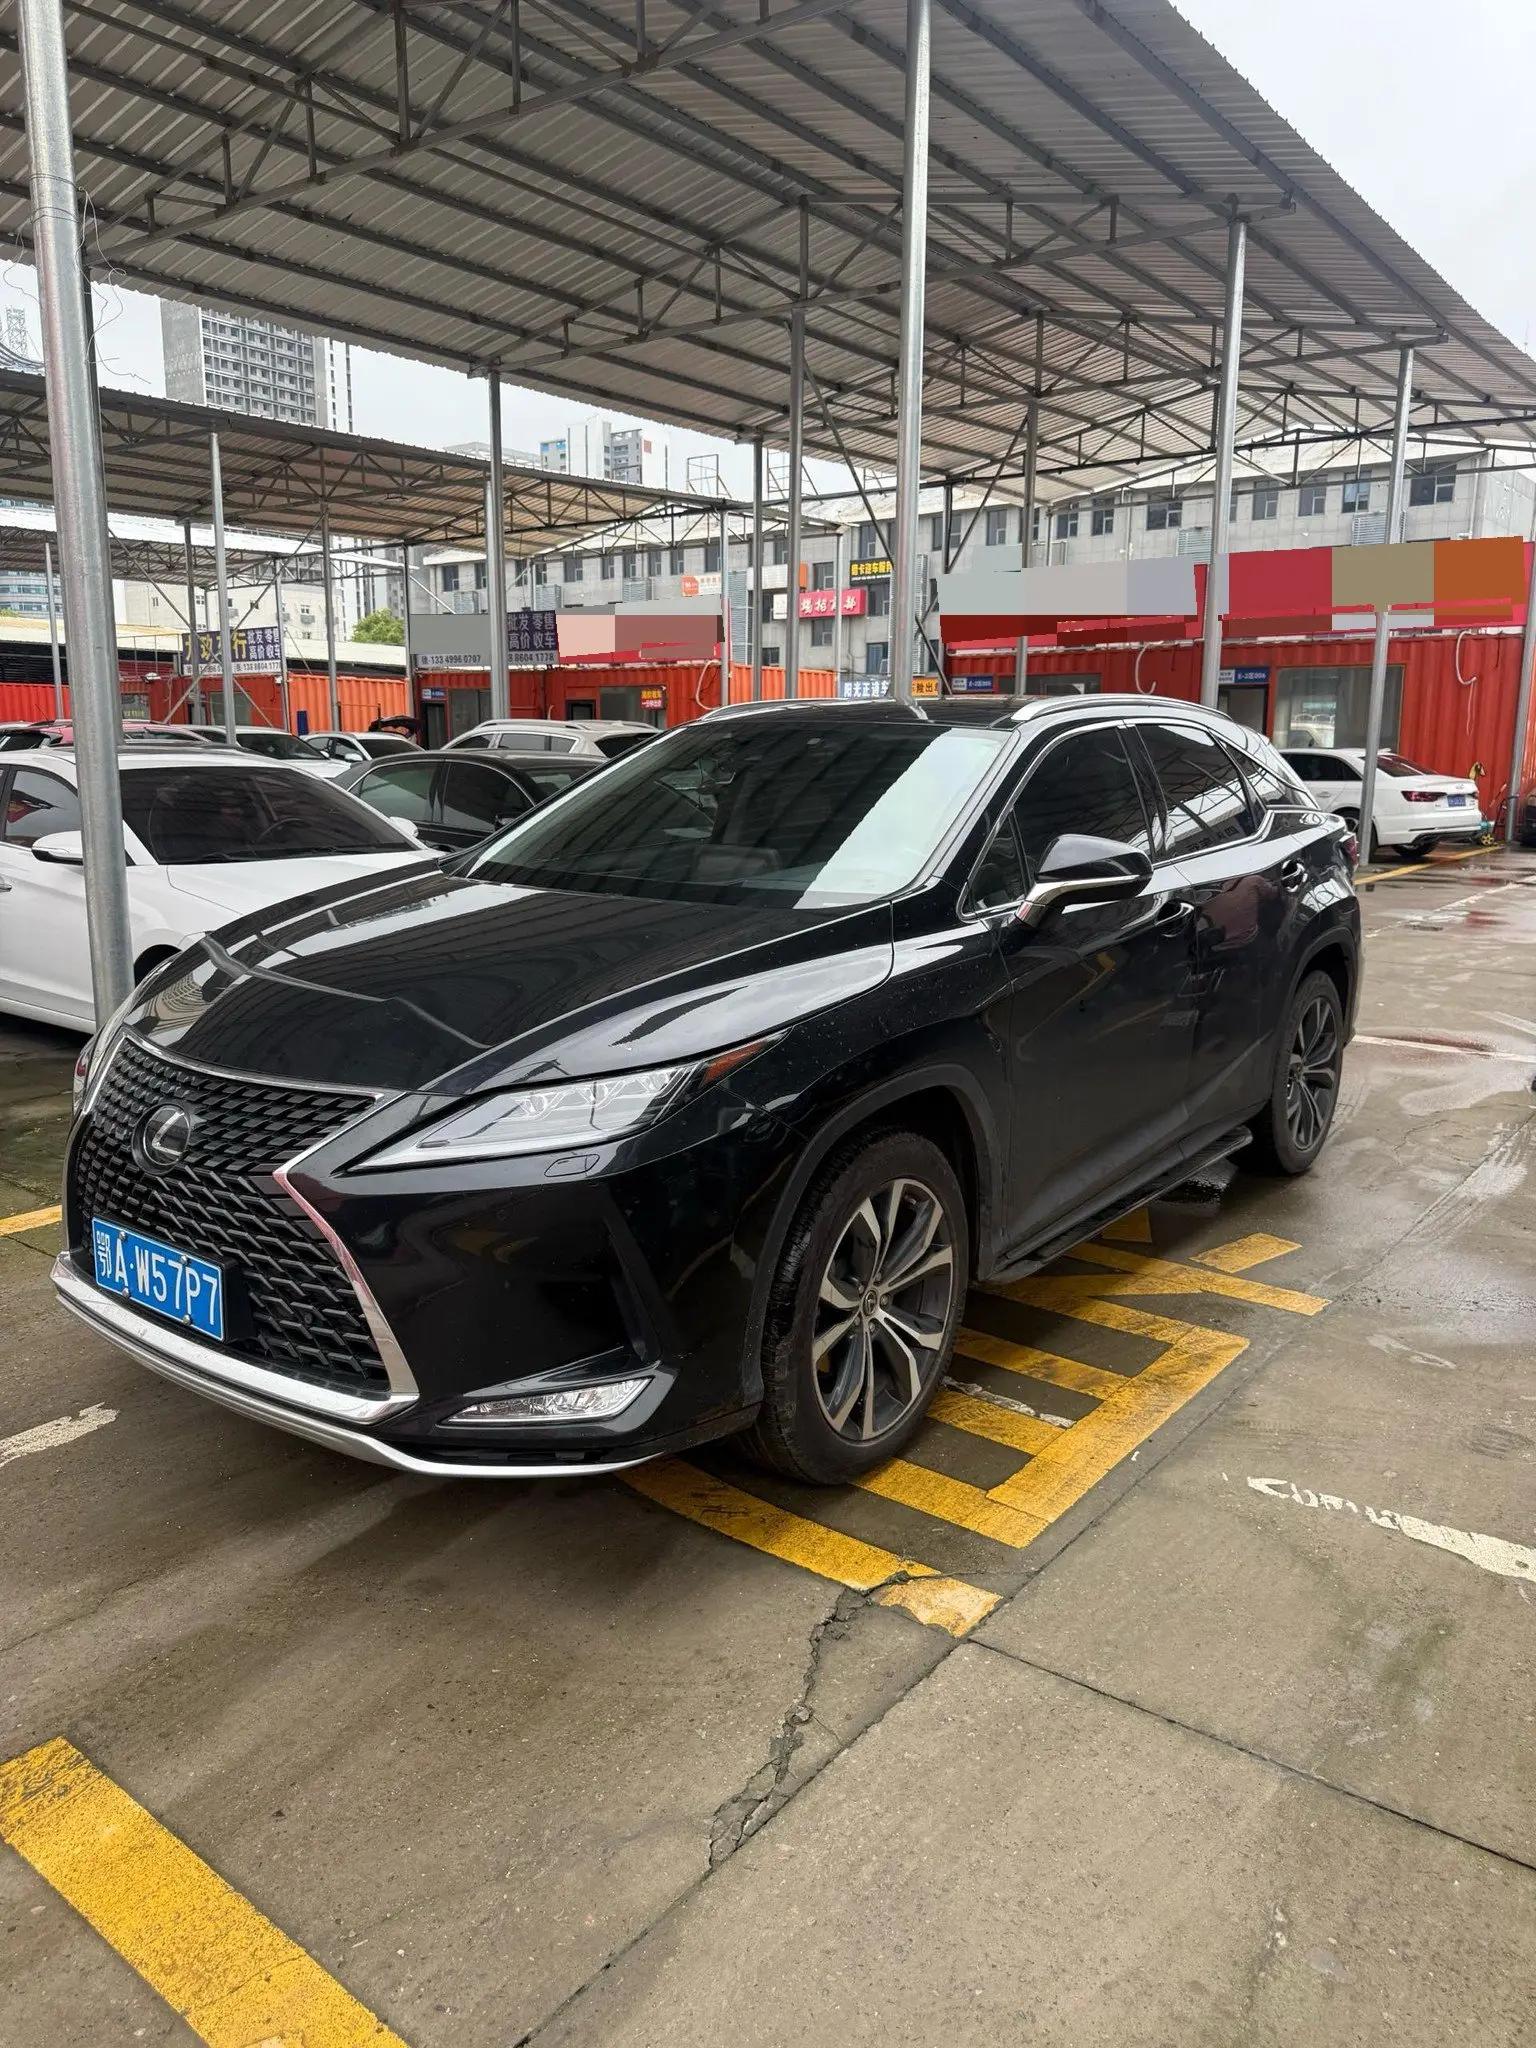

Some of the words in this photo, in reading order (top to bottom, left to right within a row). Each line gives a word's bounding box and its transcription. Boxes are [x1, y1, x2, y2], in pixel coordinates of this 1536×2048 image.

[533, 611, 555, 631] 零售
[509, 632, 531, 649] 高价
[533, 630, 556, 649] 收车
[249, 644, 265, 660] 高价
